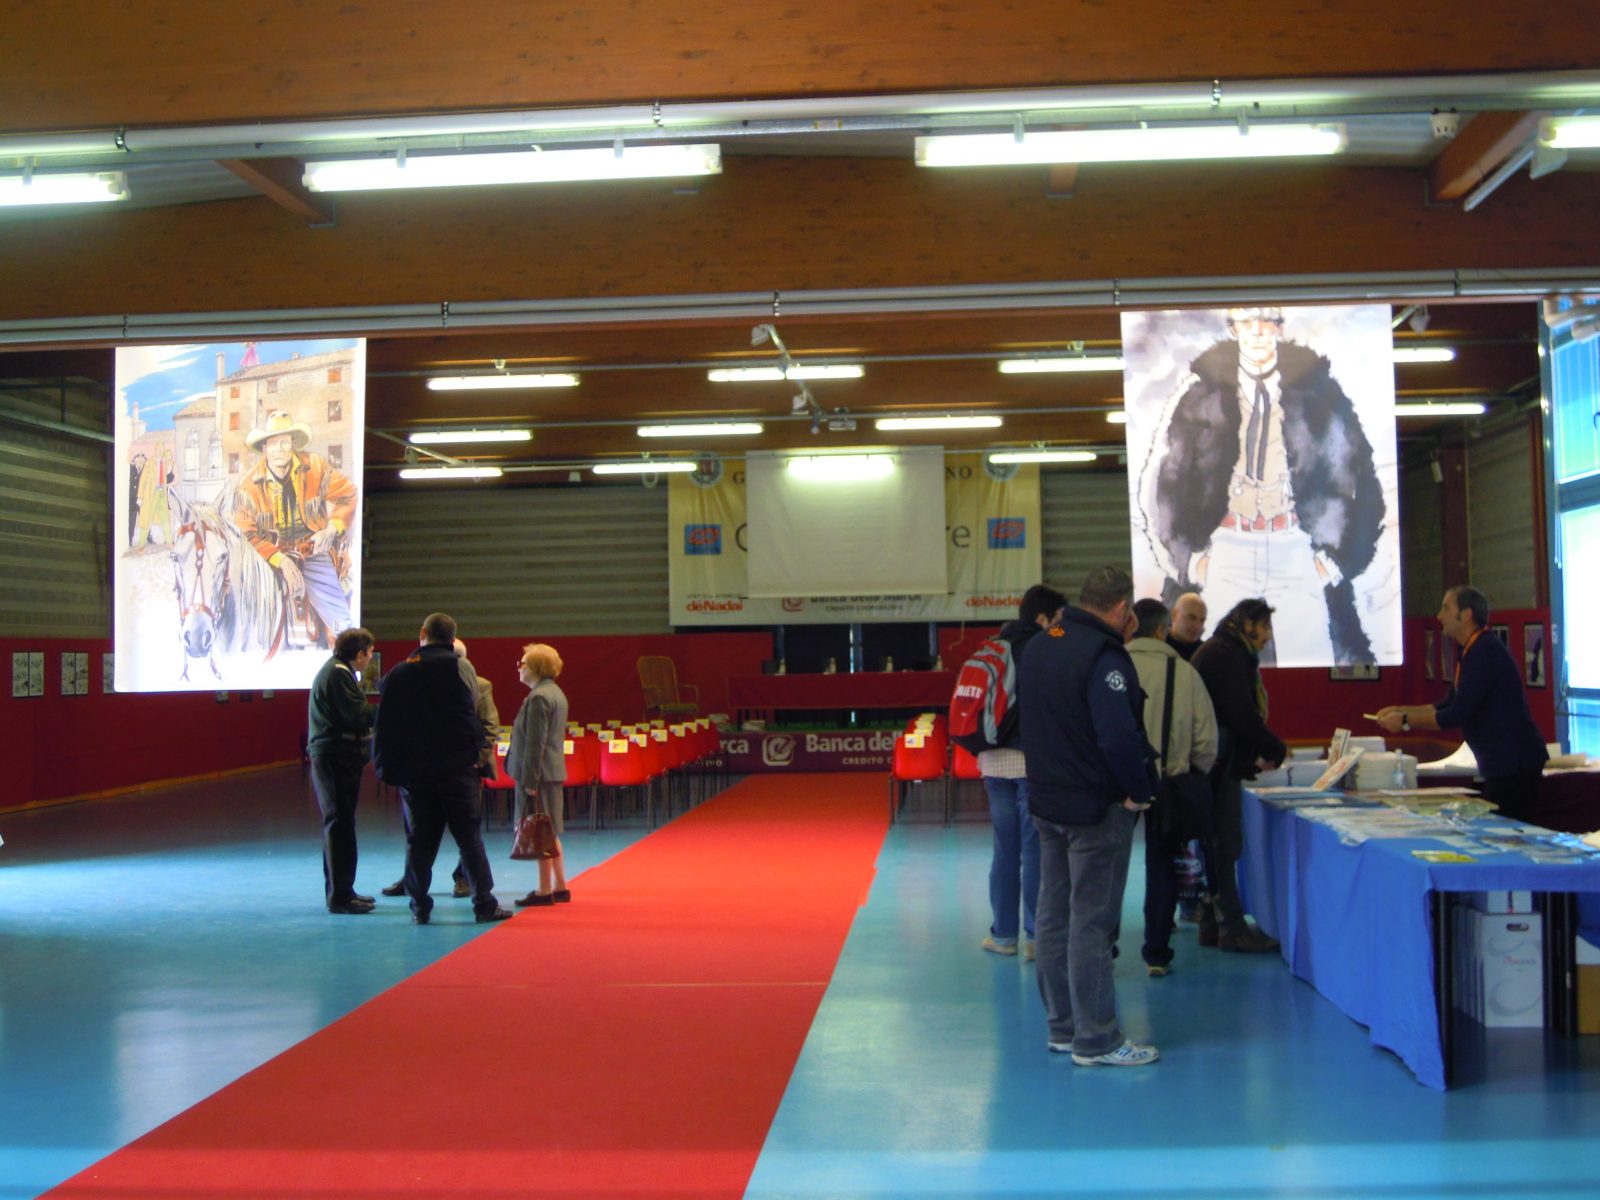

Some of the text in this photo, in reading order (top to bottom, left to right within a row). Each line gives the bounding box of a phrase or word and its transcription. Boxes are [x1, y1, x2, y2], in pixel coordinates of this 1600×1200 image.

[719, 738, 749, 754] rca
[805, 731, 904, 753] Banca del
[842, 756, 884, 765] CREDITO
